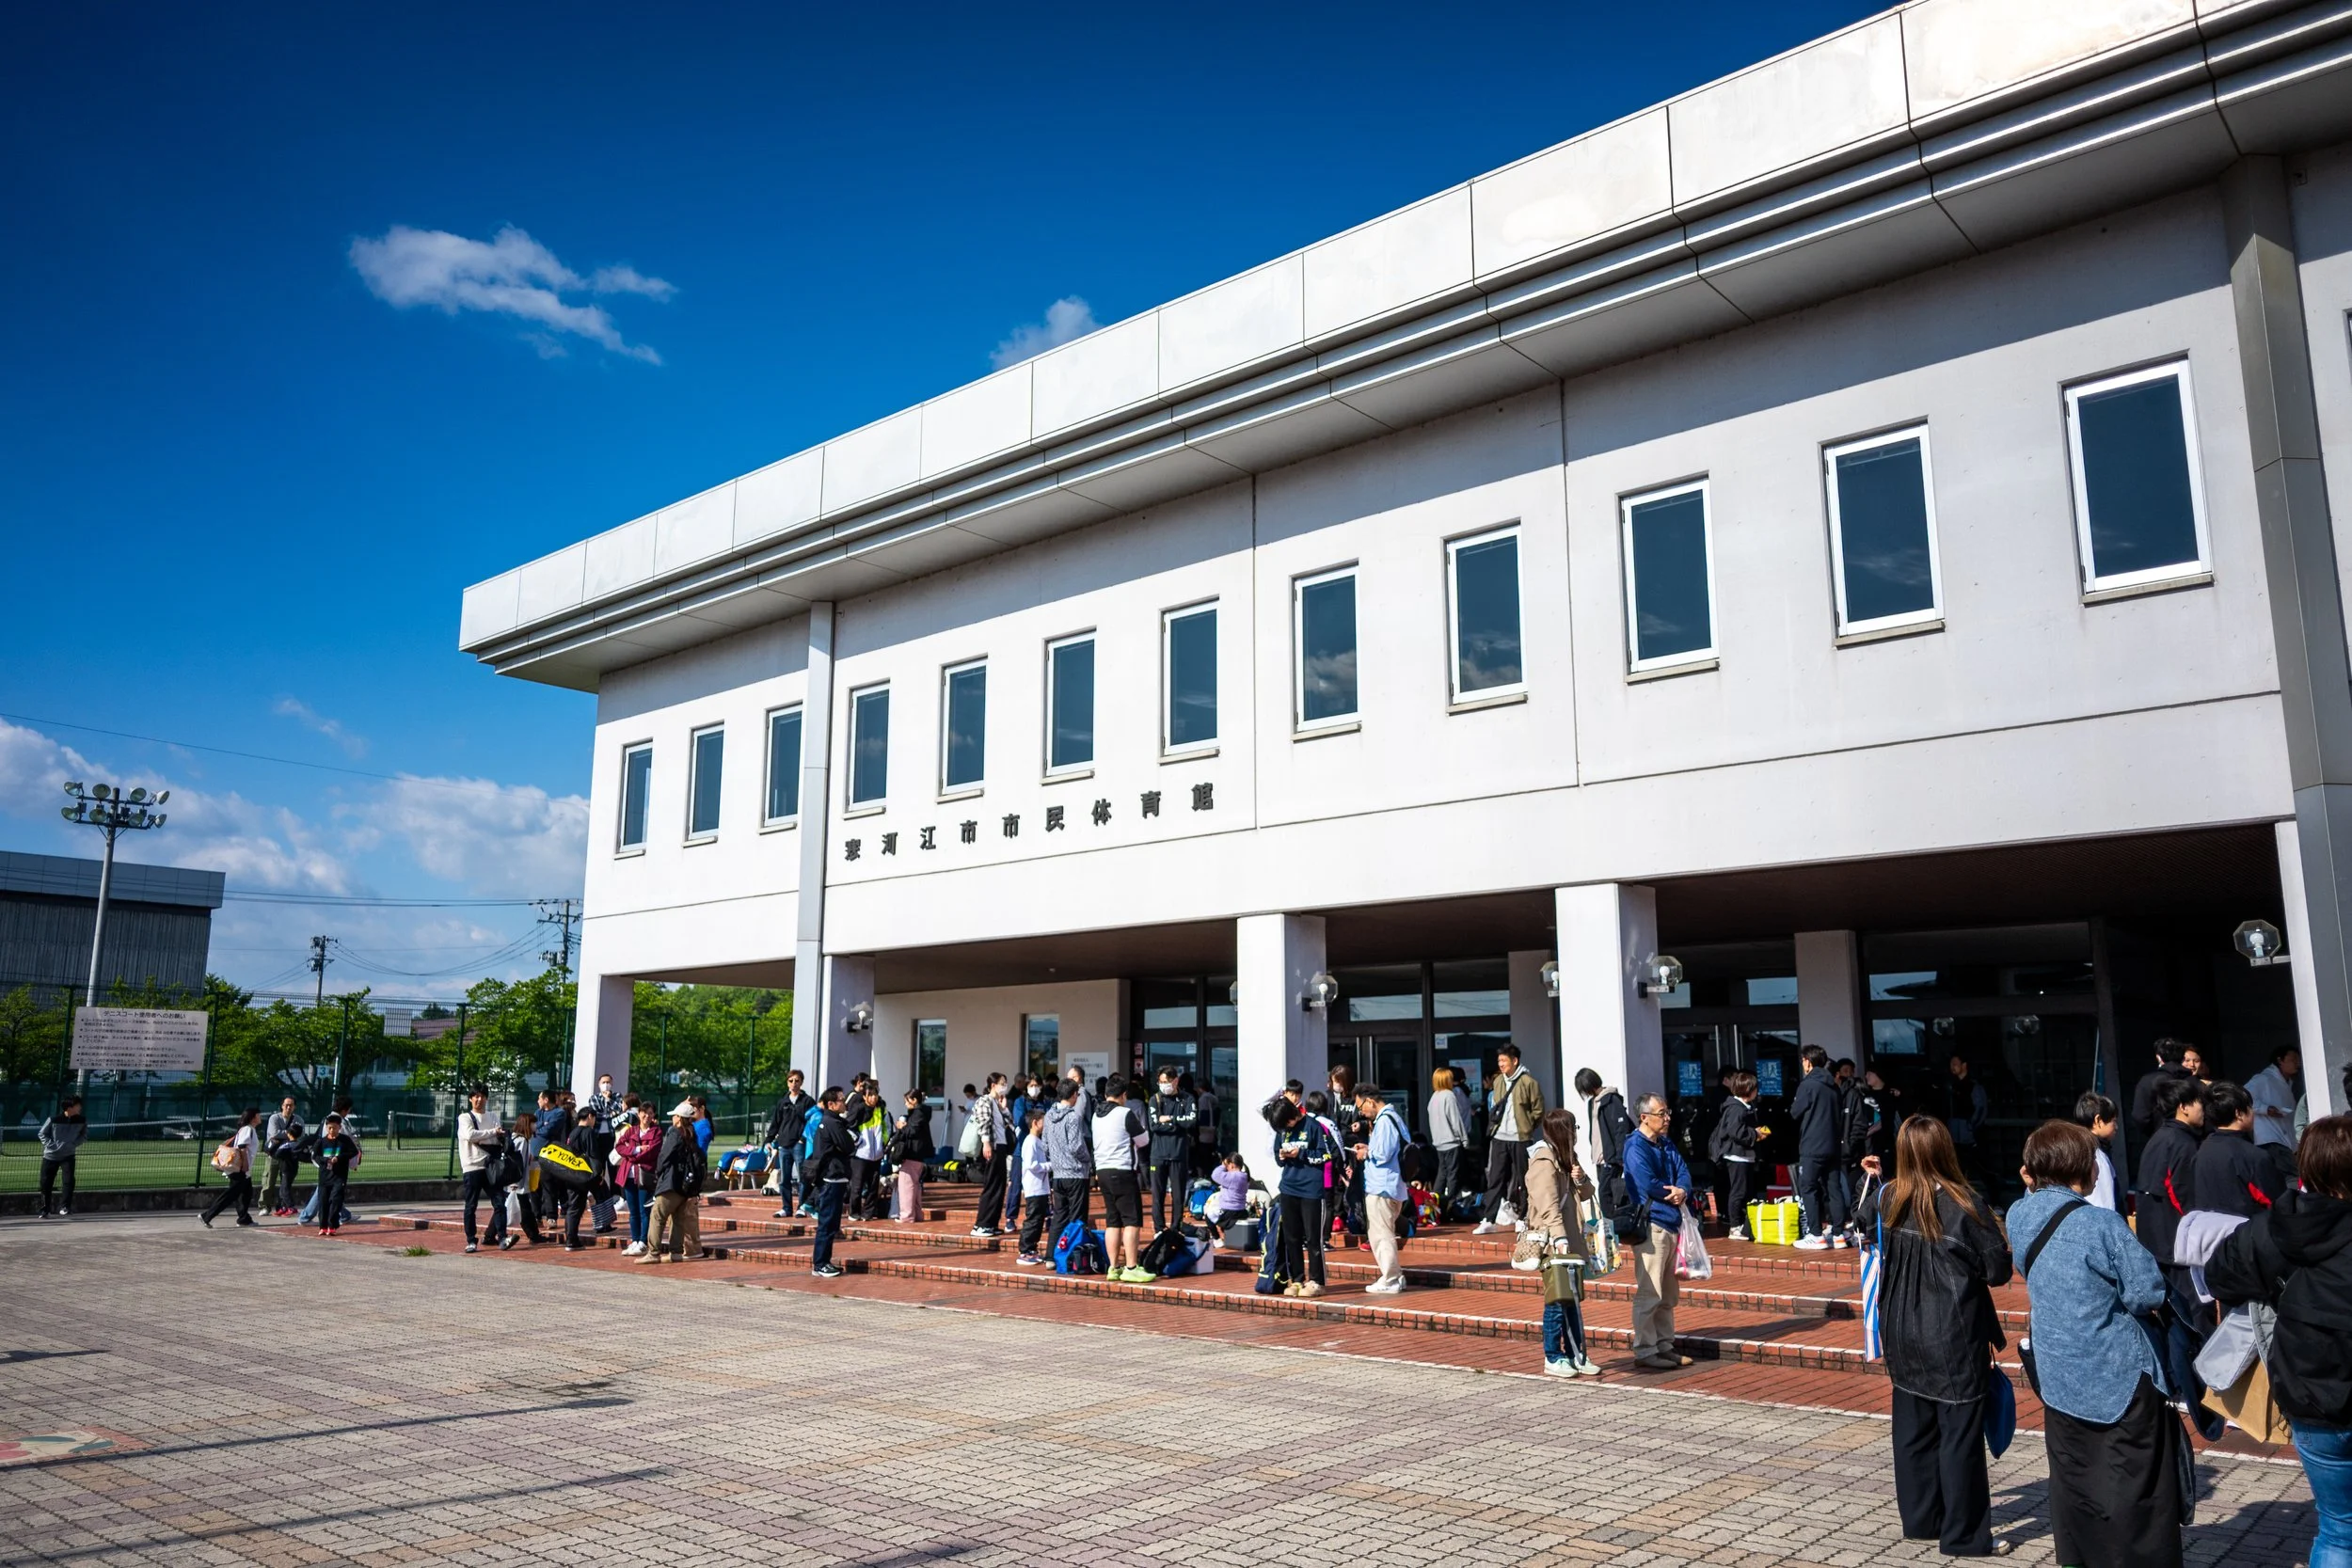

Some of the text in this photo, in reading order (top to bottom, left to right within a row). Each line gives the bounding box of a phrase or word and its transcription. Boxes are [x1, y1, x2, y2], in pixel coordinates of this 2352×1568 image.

[845, 782, 1214, 862] 寒河江市市民体育館
[557, 1150, 583, 1167] YONEX
